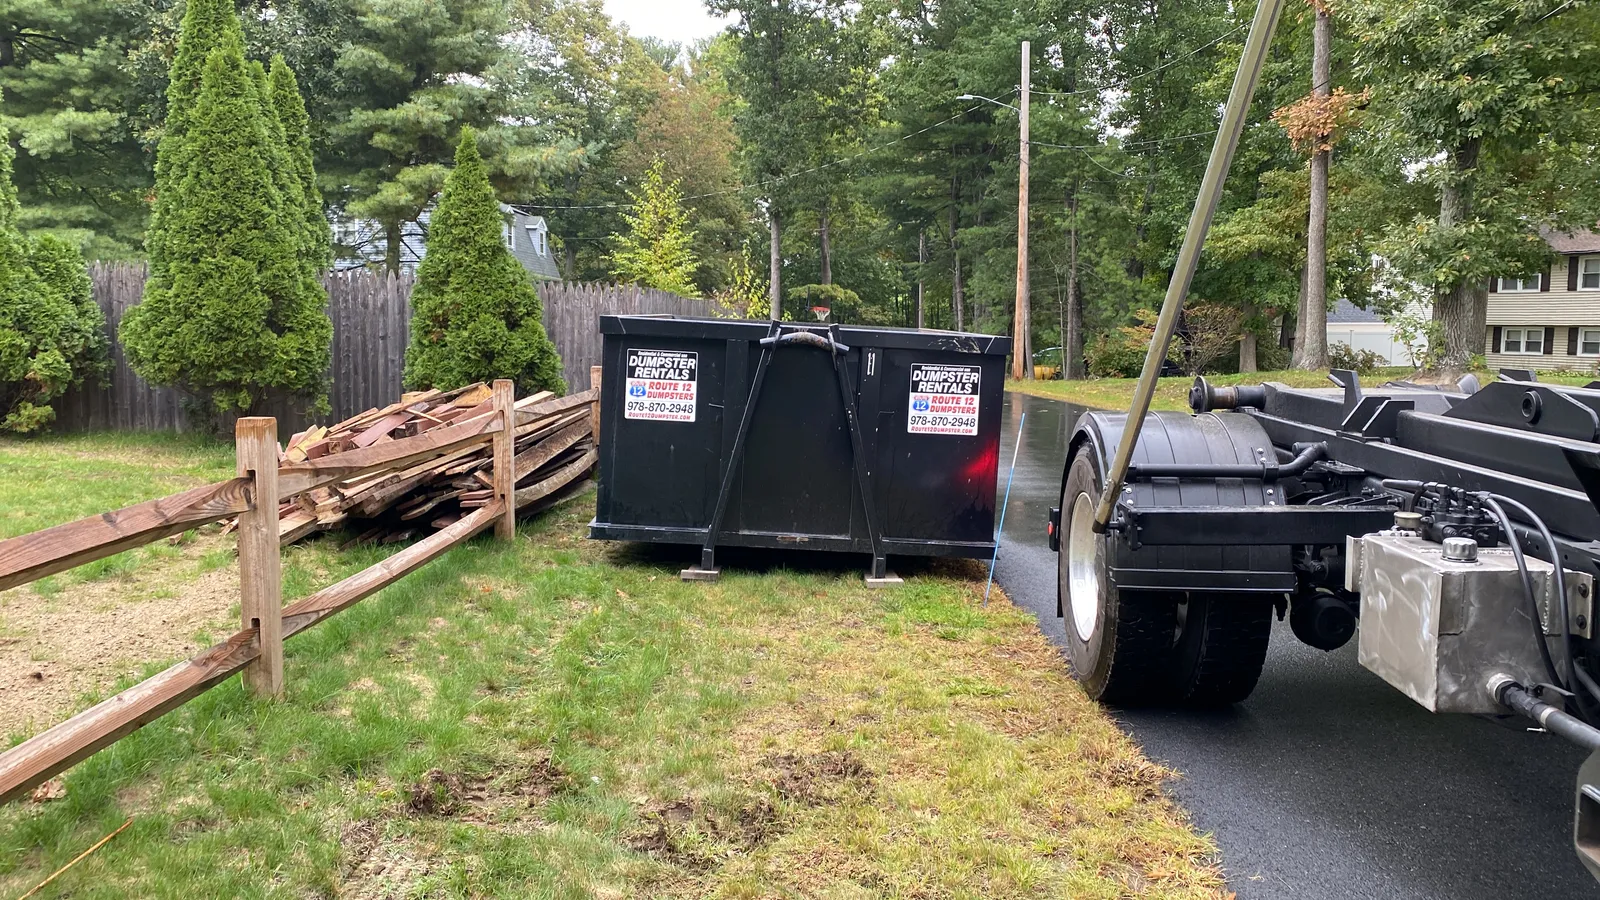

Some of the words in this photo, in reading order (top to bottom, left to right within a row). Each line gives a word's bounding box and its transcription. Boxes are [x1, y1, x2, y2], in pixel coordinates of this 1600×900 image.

[629, 355, 696, 369] DUMPSTER
[634, 367, 690, 380] RENTALS
[912, 370, 979, 384] DUMPSTER
[632, 387, 643, 396] 12
[648, 381, 679, 391] ROUTE
[682, 383, 692, 391] 12
[917, 381, 973, 394] RENTALS
[647, 391, 694, 401] DUMPSTERS
[931, 395, 962, 405] ROUTE
[965, 397, 974, 405] 12
[627, 401, 694, 414] 978-870-2948
[915, 401, 926, 410] 12
[930, 405, 976, 415] DUMPSTERS
[910, 415, 976, 428] 978-870-2948
